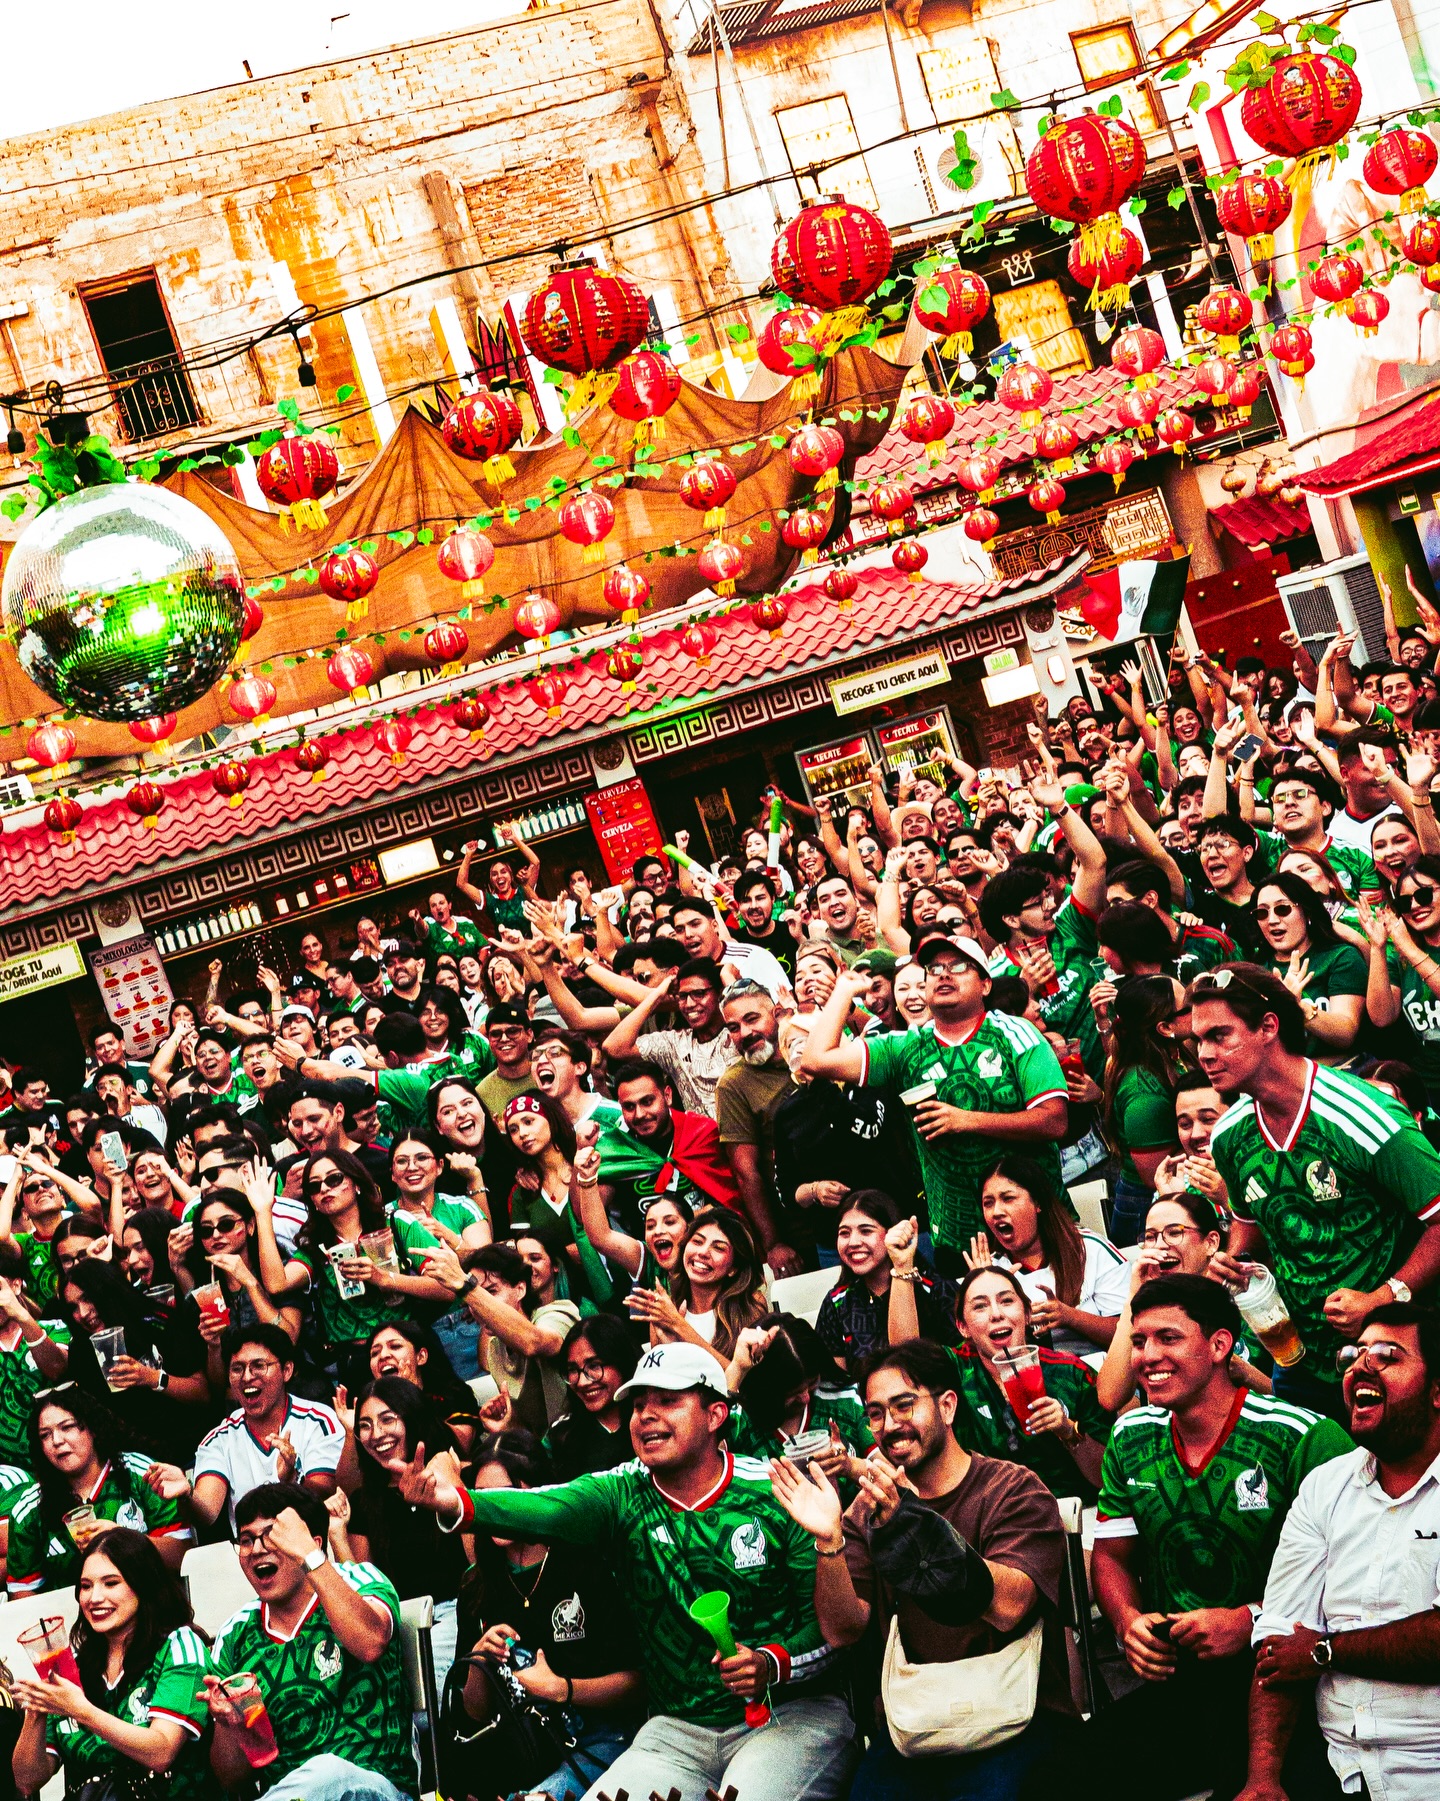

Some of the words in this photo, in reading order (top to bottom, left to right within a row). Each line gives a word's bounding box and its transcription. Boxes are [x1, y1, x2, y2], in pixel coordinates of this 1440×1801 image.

[840, 683, 876, 703] RECOGE
[875, 679, 889, 692] TU
[889, 670, 917, 687] CHEVE
[917, 660, 940, 679] AQUÍ
[892, 722, 920, 738] TECATE
[813, 748, 842, 763] TECATE
[597, 784, 630, 801] CERVEZA
[601, 822, 634, 840] CERVEZA
[102, 940, 144, 961] MIXOLOGÍA
[27, 959, 43, 973] TU
[41, 963, 63, 980] AQUÍ
[642, 1350, 665, 1369] NY
